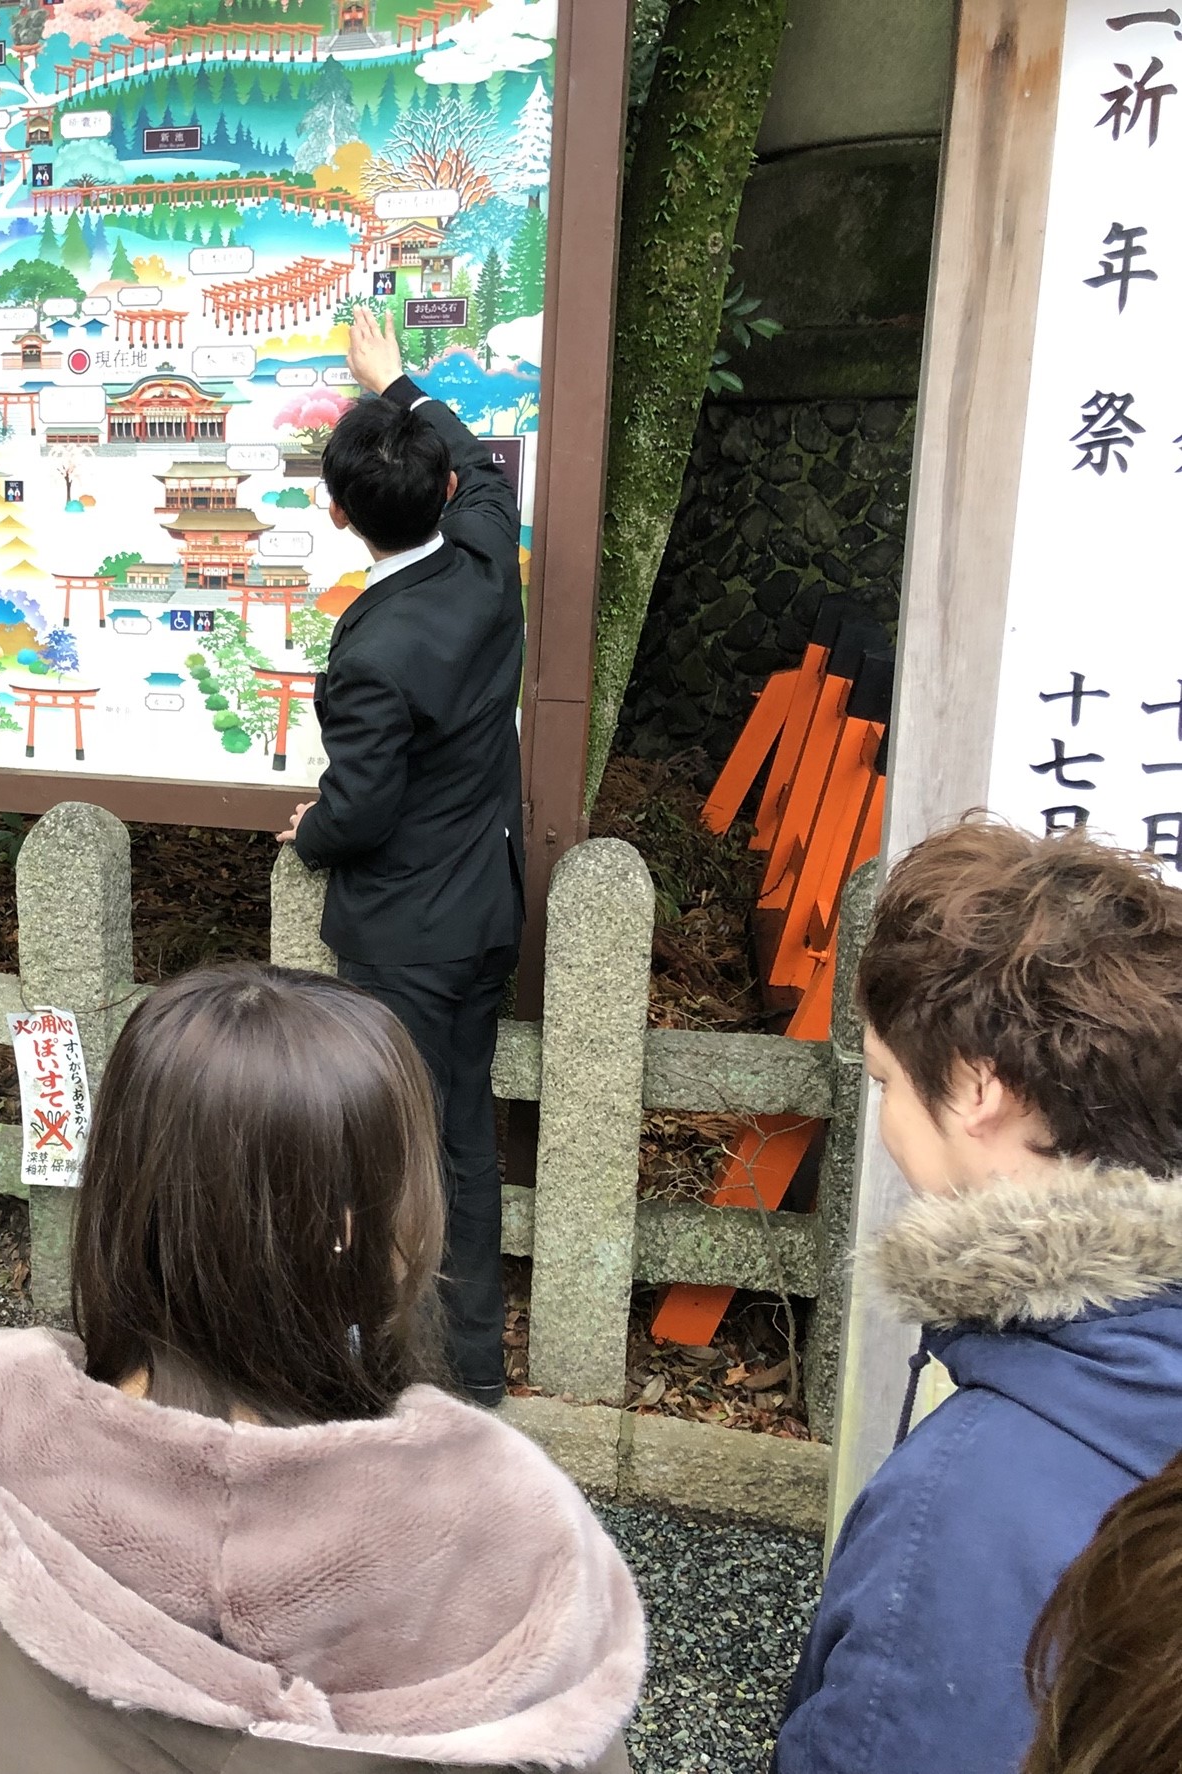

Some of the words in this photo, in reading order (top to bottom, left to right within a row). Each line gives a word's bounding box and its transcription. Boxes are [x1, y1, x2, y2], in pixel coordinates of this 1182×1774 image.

[378, 272, 391, 280] WC
[414, 302, 458, 314] おもかる石
[95, 349, 148, 369] 現在地
[13, 1014, 74, 1036] 火の用心
[33, 1038, 65, 1108] ぽいすて
[63, 1038, 88, 1140] すいがら、あきかん
